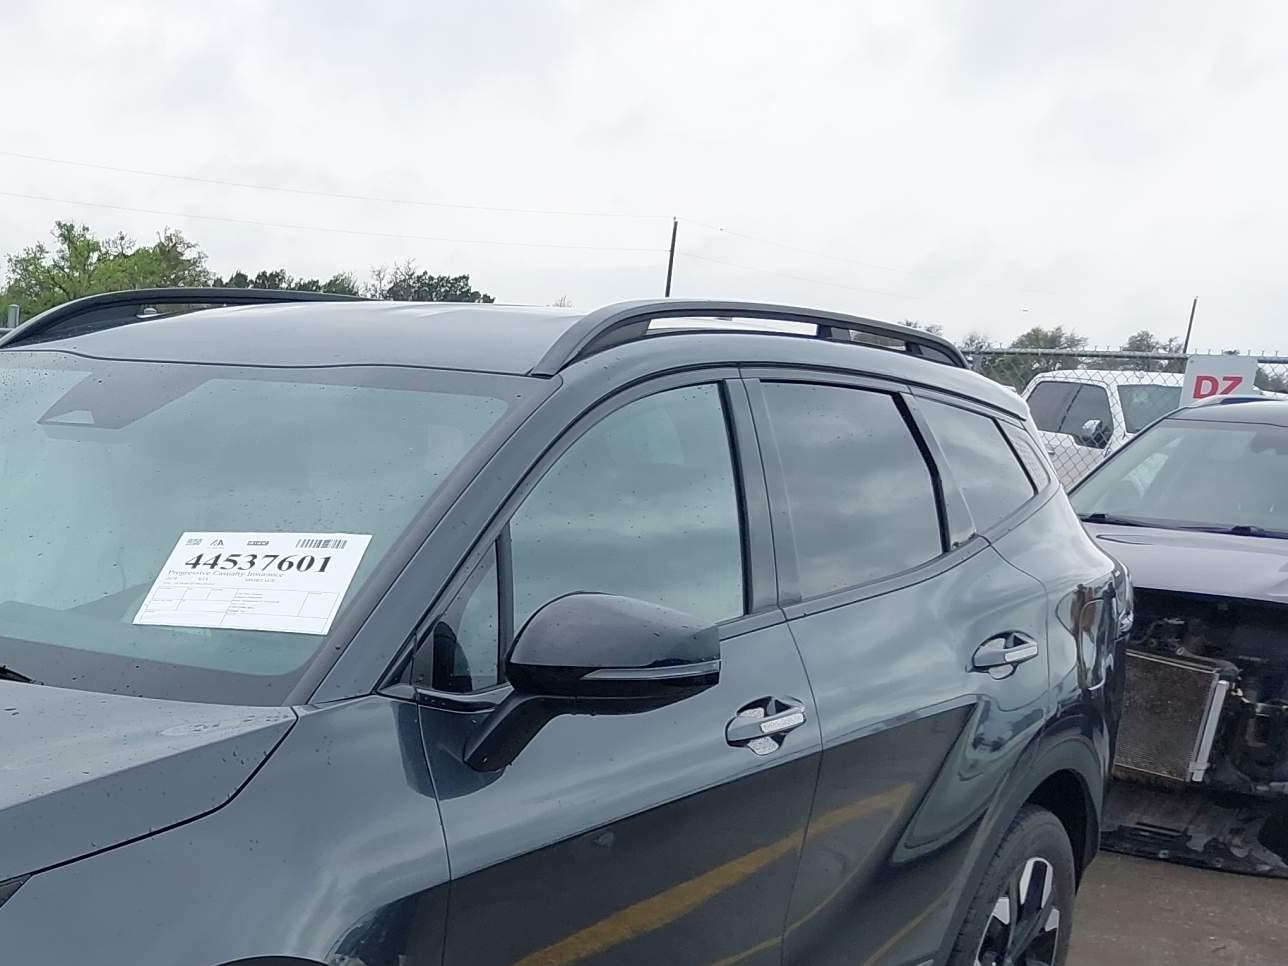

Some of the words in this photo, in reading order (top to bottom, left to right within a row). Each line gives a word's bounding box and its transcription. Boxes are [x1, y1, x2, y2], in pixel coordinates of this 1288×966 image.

[184, 553, 333, 573] 44537601
[168, 569, 211, 577] Progressive
[212, 570, 245, 578] Casualty
[246, 570, 287, 578] Insurance
